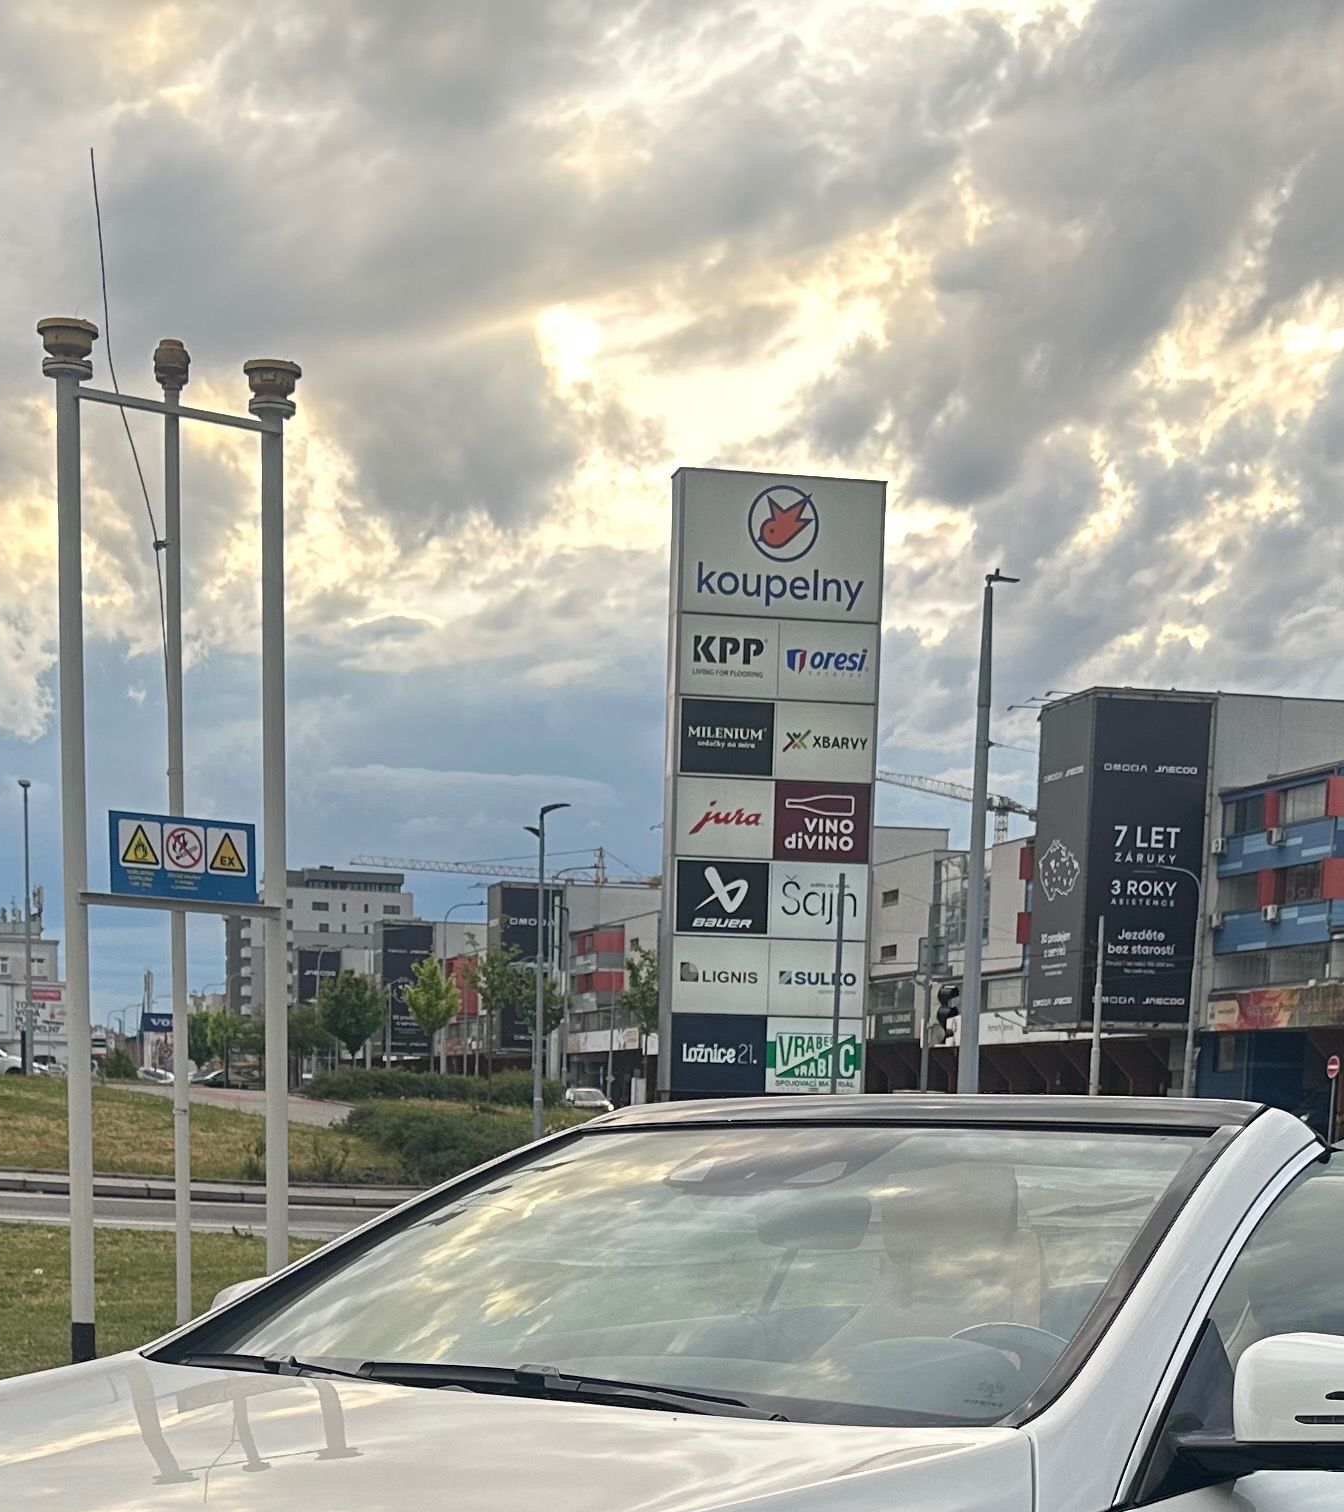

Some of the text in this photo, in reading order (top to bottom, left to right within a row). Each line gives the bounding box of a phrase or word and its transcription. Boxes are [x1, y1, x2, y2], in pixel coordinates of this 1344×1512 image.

[697, 561, 864, 611] koupelny
[693, 635, 764, 665] KPP
[810, 648, 868, 671] oresi
[688, 726, 763, 741] MILENIUM
[813, 736, 868, 750] XBARVY
[689, 800, 761, 835] jura
[805, 817, 854, 835] VINO
[784, 833, 854, 851] diVINO
[1114, 825, 1181, 849] 7 LET
[220, 856, 235, 866] EX
[1114, 851, 1177, 864] ZÁRUKY
[1111, 880, 1177, 897] 3 ROKY
[509, 917, 556, 926] OMOA
[691, 917, 753, 930] BAUER
[1107, 943, 1128, 954] bez
[702, 970, 758, 984] LIGNIS
[682, 1043, 736, 1064] Ložnice
